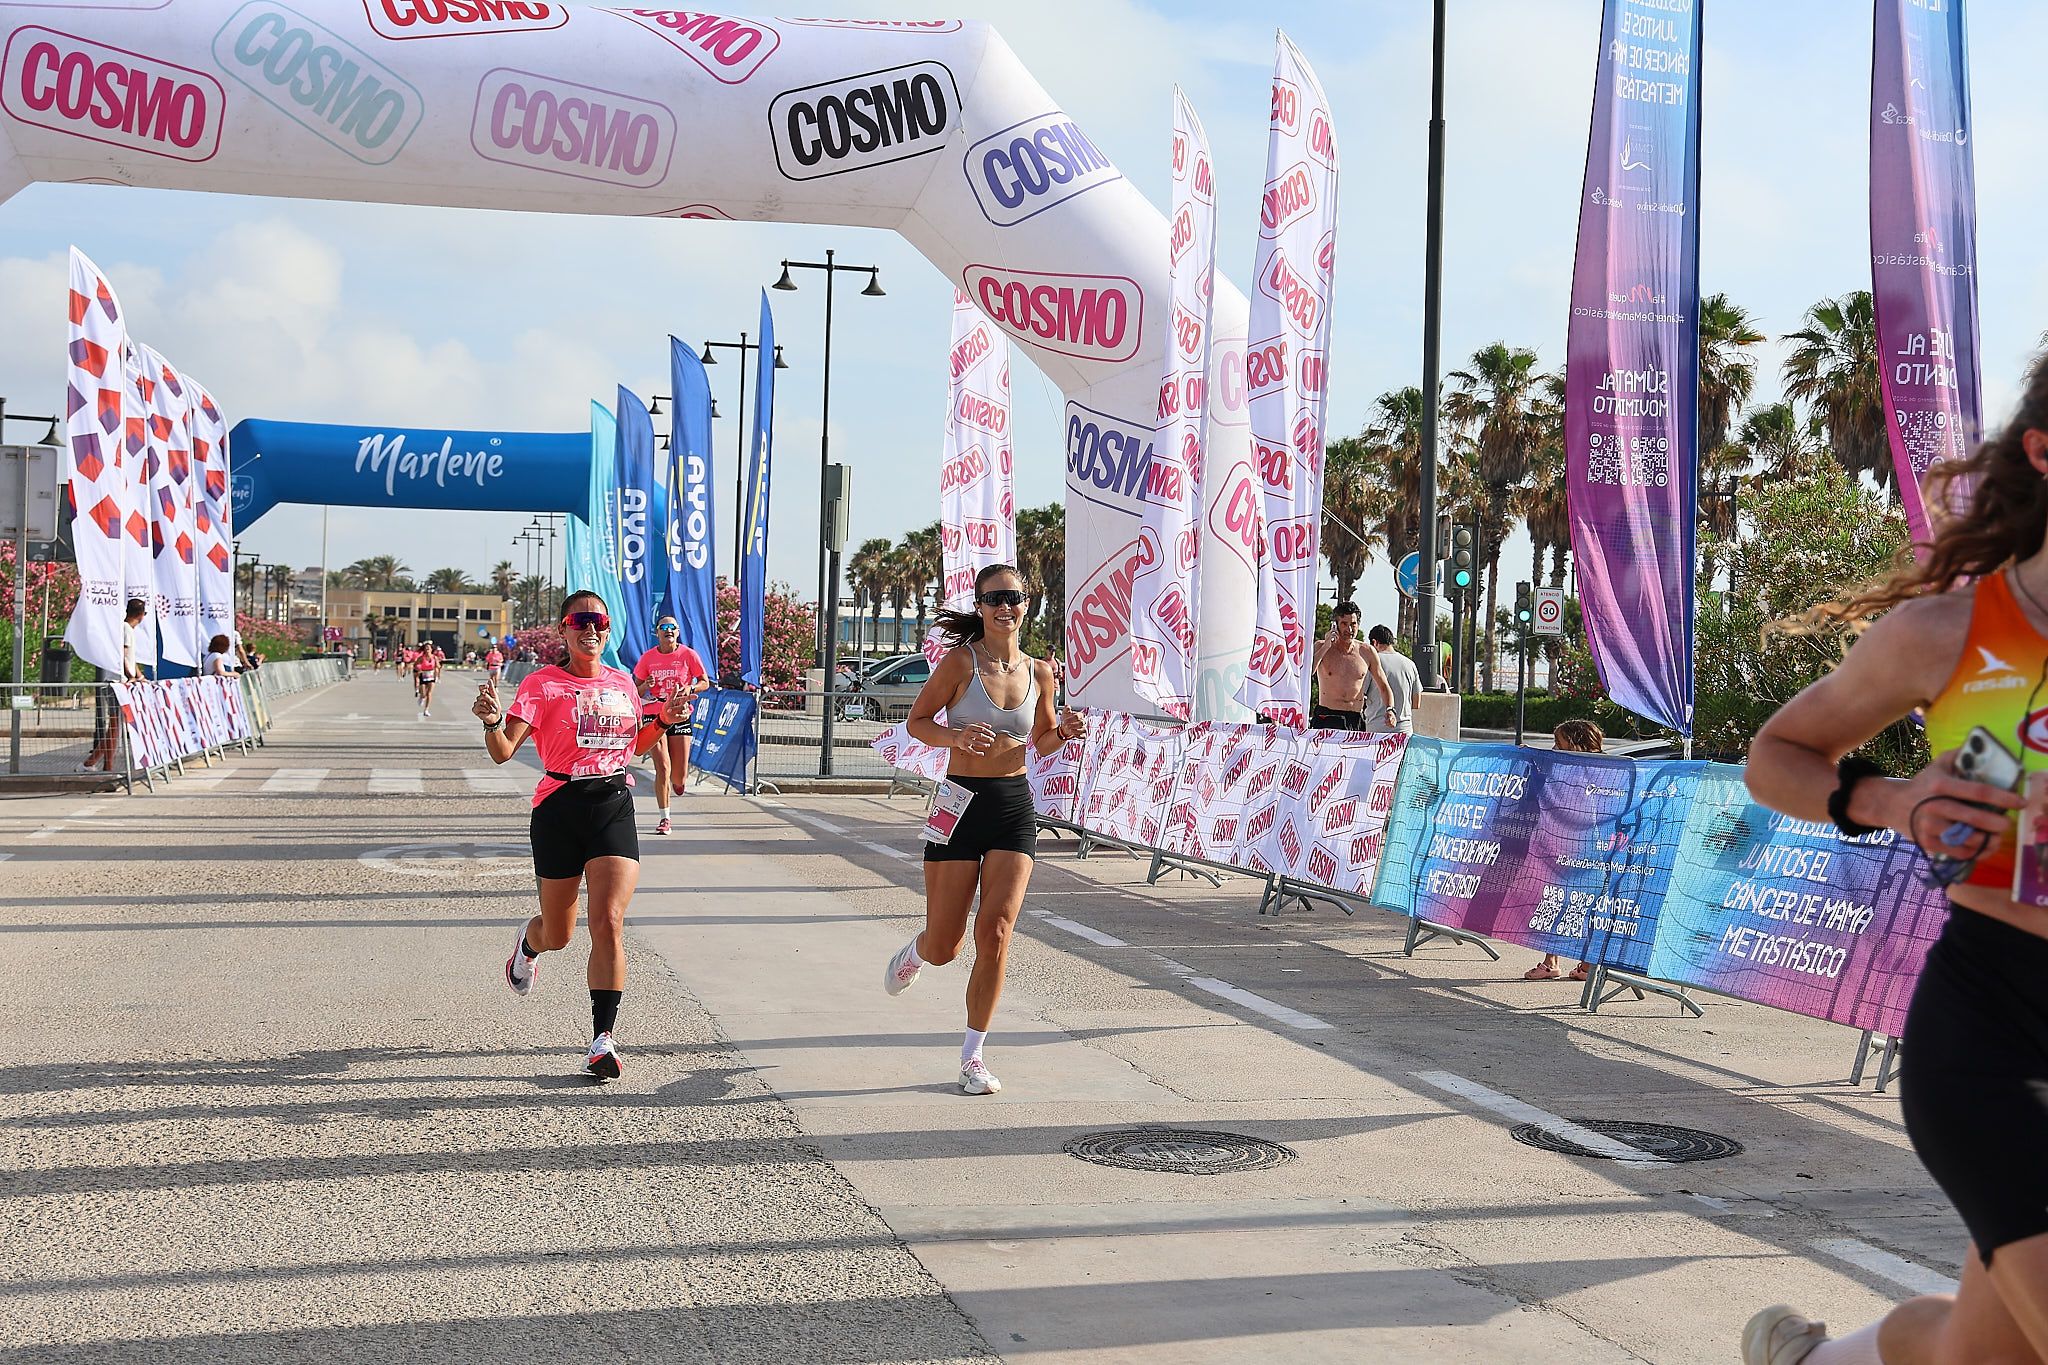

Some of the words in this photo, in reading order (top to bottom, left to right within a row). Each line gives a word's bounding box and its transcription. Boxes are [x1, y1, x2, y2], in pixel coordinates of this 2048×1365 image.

[21, 41, 206, 148] COSMO
[233, 12, 405, 149] COSMO
[490, 83, 659, 176] COSMO
[787, 73, 947, 166] COSMO
[983, 122, 1110, 208] COSM
[977, 276, 1125, 348] COSMO
[355, 434, 503, 496] Marlene
[1068, 415, 1152, 500] COSM
[1067, 554, 1140, 679] COSM
[1543, 607, 1555, 615] 30
[1044, 776, 1074, 796] COSMO
[1247, 764, 1276, 799] COSMO
[1281, 764, 1309, 798] COSMO
[1310, 762, 1343, 813] COSMO
[1212, 819, 1238, 842] COSMO
[1247, 805, 1275, 841] COSMO
[1325, 800, 1356, 832] COSMO
[1279, 818, 1301, 869] COSMO
[1308, 847, 1337, 885] COSMO
[1350, 832, 1380, 867] COSMO
[1738, 843, 1810, 878] JUNTOS
[1807, 851, 1832, 882] EL
[1588, 915, 1638, 937] MOVIMIENTO
[1592, 891, 1636, 916] SÚMATE
[1723, 877, 1799, 921] CÁNCER
[1793, 894, 1823, 926] DE
[1816, 897, 1874, 934] MAMA
[1719, 932, 1847, 979] METASTÁSICO
